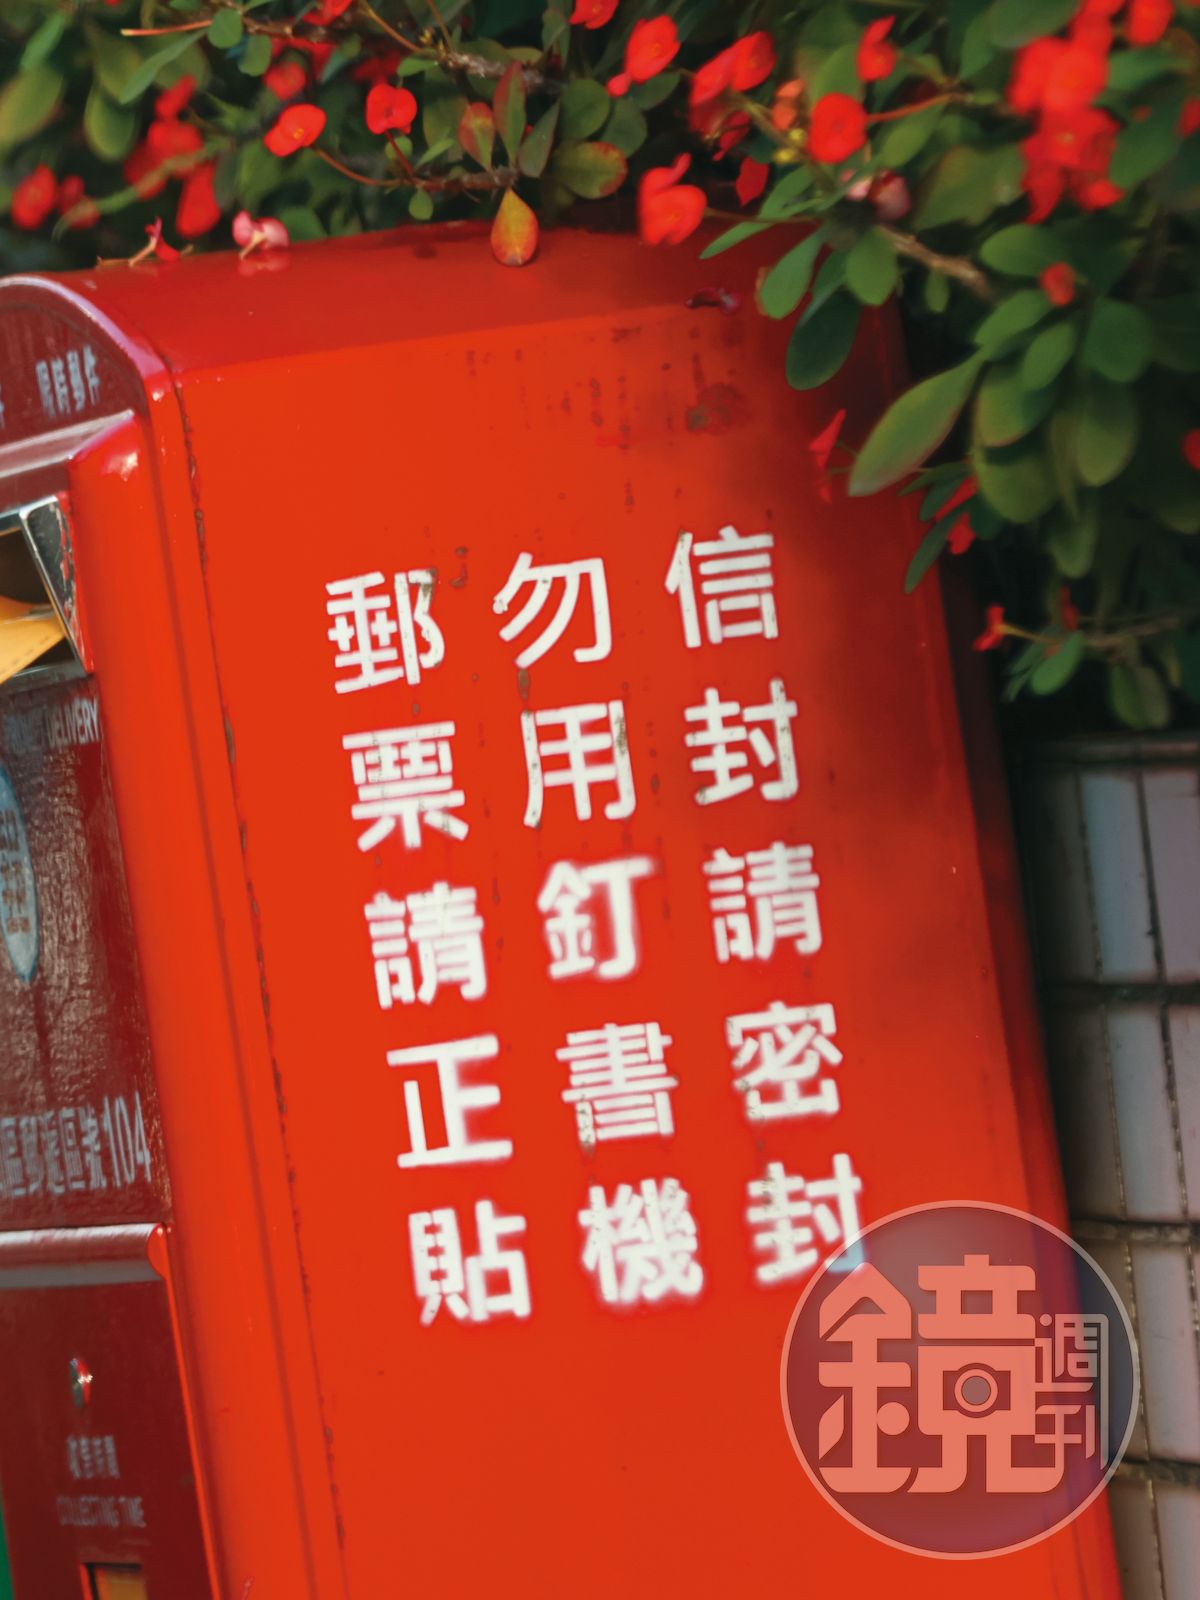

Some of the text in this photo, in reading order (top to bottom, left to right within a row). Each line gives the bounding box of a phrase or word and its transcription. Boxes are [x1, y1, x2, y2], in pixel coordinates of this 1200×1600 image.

[325, 567, 532, 1324] 郵票請正貼
[491, 551, 702, 1304] 勿用釘書機
[664, 524, 866, 1290] 信封請密封
